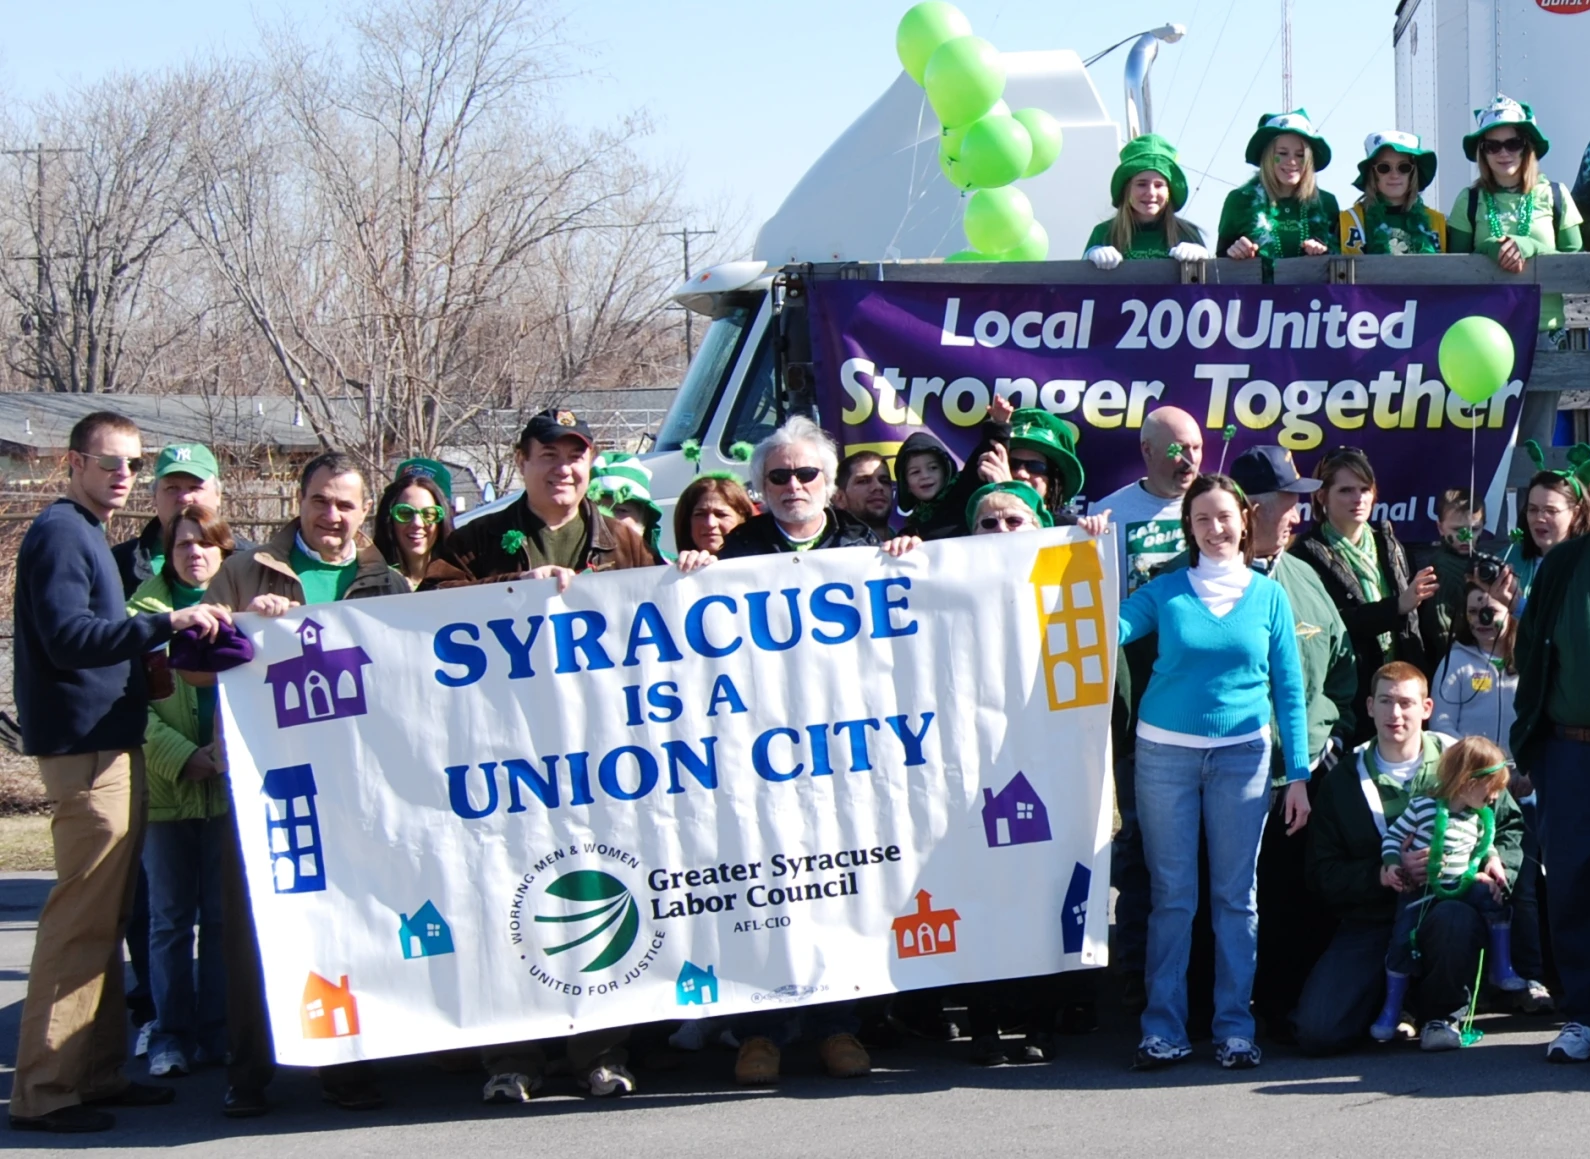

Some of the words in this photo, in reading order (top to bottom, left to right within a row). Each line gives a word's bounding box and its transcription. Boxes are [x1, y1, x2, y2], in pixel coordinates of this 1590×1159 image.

[940, 297, 1095, 349] Local
[840, 357, 1165, 444] Stronger
[1194, 364, 1524, 450] Together
[432, 576, 919, 687] SYRACUSE
[622, 681, 684, 726] IS
[706, 674, 748, 716] A
[444, 736, 719, 819] UNION
[751, 712, 935, 783] CITY
[510, 873, 535, 945] WORKING
[534, 848, 565, 872] MEN
[569, 845, 578, 855] &
[584, 843, 639, 869] WOMEN
[648, 861, 762, 892] Greater
[771, 844, 902, 878] Syracuse
[650, 890, 735, 920] Labor
[746, 872, 859, 911] Council
[529, 964, 582, 996] UNITED
[588, 980, 619, 996] FOR
[624, 930, 666, 985] JUSTICE
